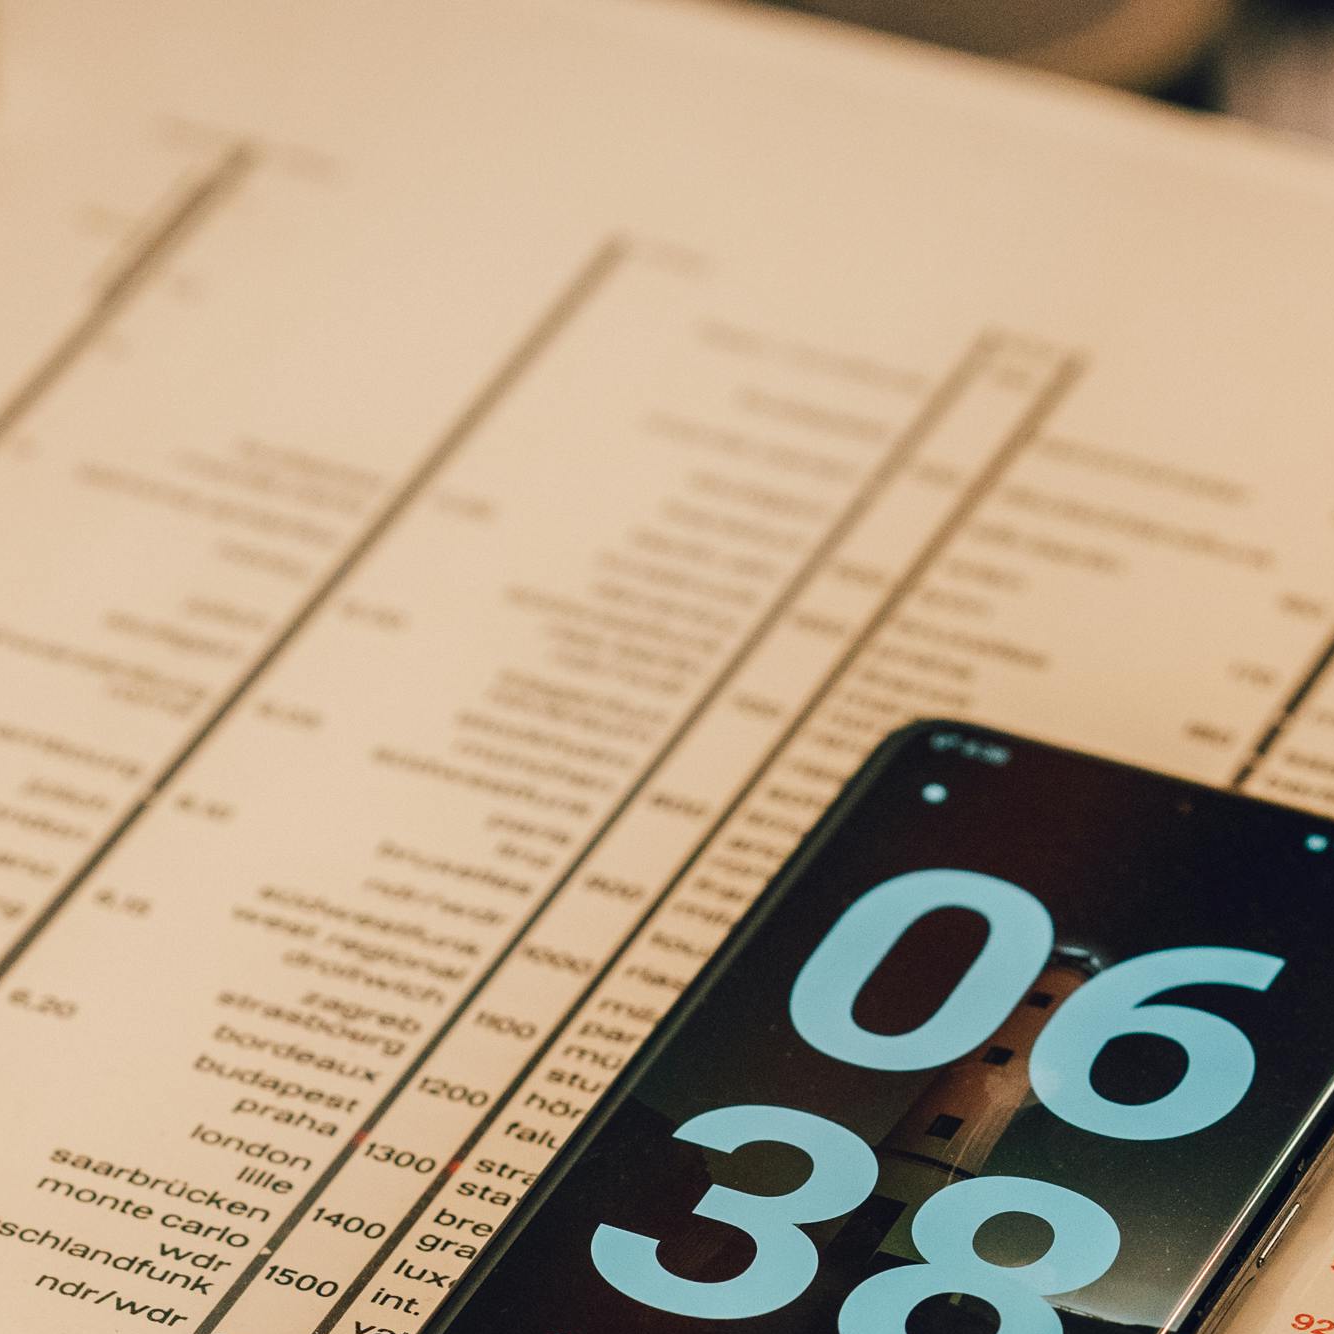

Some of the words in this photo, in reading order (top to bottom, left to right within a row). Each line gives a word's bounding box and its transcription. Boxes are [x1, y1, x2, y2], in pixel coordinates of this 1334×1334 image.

[789, 868, 1286, 1141] 06
[212, 1024, 382, 1083] bordeaux
[192, 1054, 359, 1114] budapest
[419, 1076, 489, 1107] 1200
[232, 1096, 340, 1138] praha
[189, 1123, 312, 1171] london
[364, 1142, 436, 1174] 1300
[49, 1146, 271, 1223] saarbrücken
[235, 1165, 295, 1195] lille
[456, 1180, 519, 1206] sta
[37, 1176, 154, 1220] monte
[160, 1212, 250, 1249] carlo
[313, 1207, 387, 1240] 1400
[433, 1208, 493, 1237] bre
[158, 1241, 232, 1273] wdr
[415, 1233, 477, 1260] gra
[263, 1264, 339, 1299] 1500
[35, 1273, 189, 1328] ndr/wdr
[370, 1287, 420, 1316] int.
